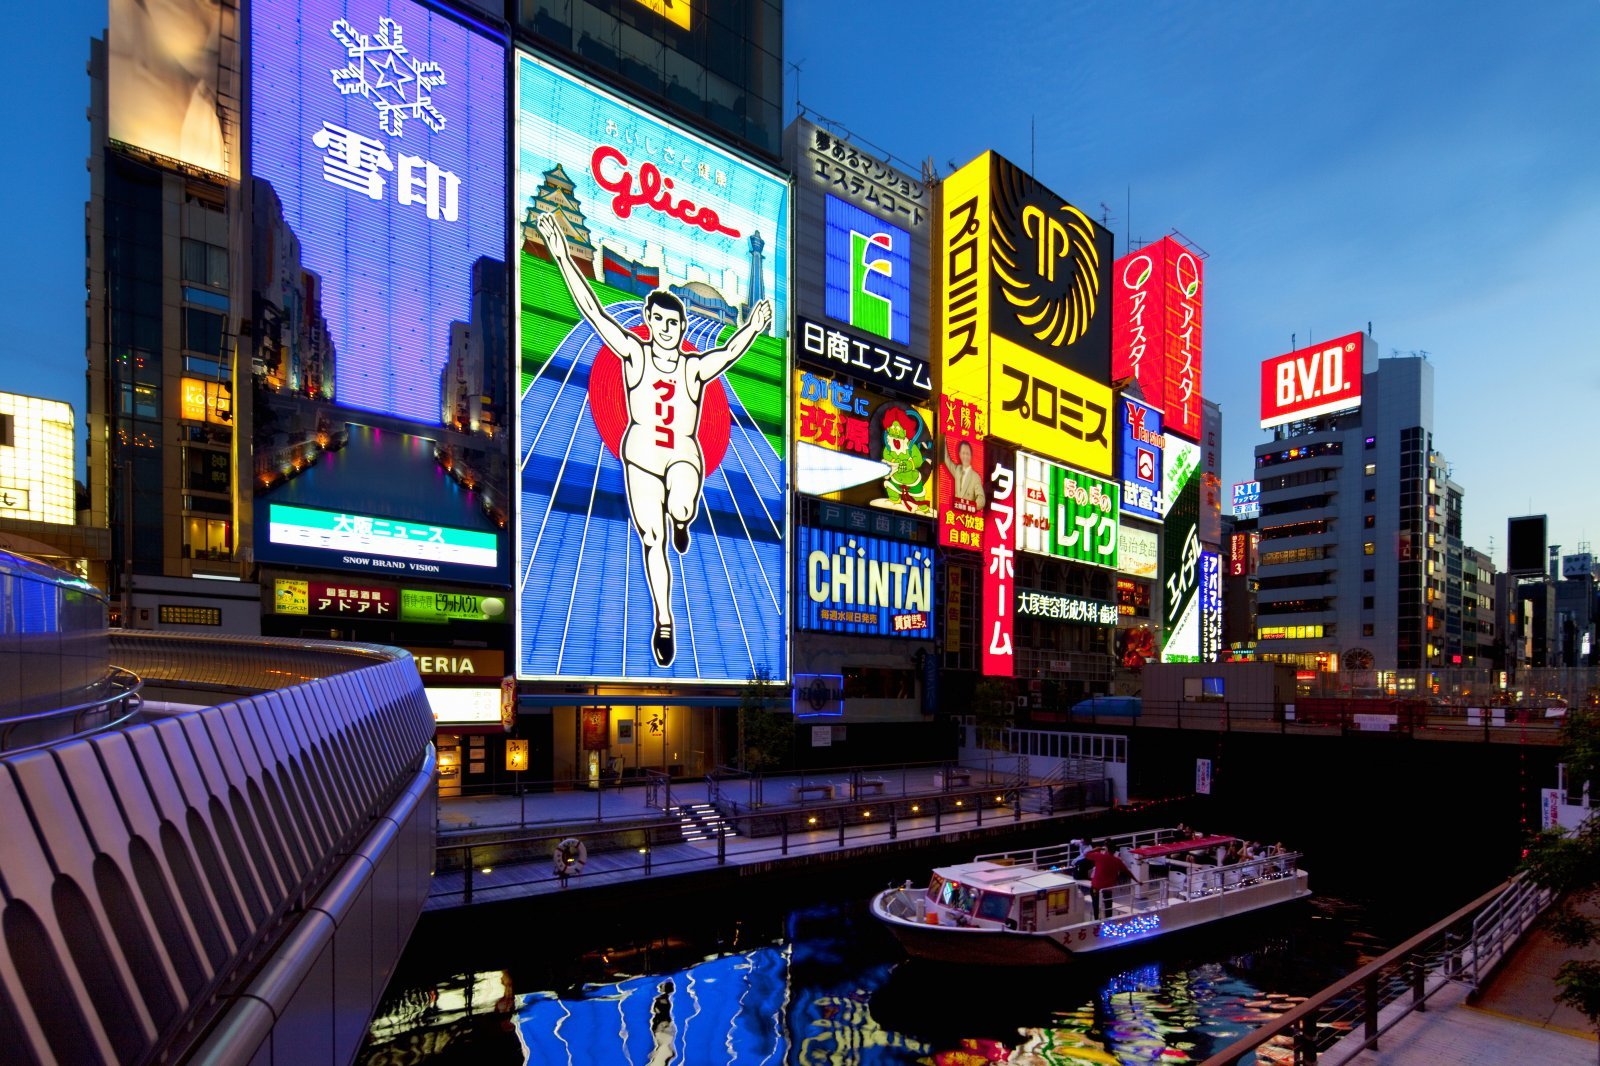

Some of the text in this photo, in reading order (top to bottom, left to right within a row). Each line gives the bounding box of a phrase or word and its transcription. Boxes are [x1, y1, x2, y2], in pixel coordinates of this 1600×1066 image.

[312, 121, 461, 222] 雪印
[605, 118, 727, 188] おいしさと健康
[815, 129, 924, 199] 夢あるマンション
[591, 145, 741, 238] Glico
[815, 158, 924, 225] エステムコート
[948, 195, 979, 367] プロミス
[804, 321, 933, 391] 日商エステム
[1128, 290, 1147, 381] アイスター
[1178, 302, 1195, 425] アイスター
[652, 379, 677, 449] グリコ
[800, 370, 870, 417] かぜに
[1002, 363, 1108, 449] プロミス
[799, 402, 870, 454] 改源
[1149, 431, 1166, 451] shop
[825, 505, 913, 535] 戸堂歯科
[1029, 490, 1042, 499] 4F
[1063, 477, 1112, 514] ほのぼの
[1123, 480, 1164, 514] 武富士
[333, 513, 446, 544] 大阪ニュース
[945, 510, 985, 532] 食べ放題
[1057, 503, 1117, 556] レイク
[343, 555, 440, 573] SNOW BRAND VISION
[990, 462, 1014, 656] タマホーム
[1166, 522, 1203, 622] エイブル
[1234, 563, 1242, 575] 3
[1237, 534, 1245, 561] カラオケ
[318, 598, 390, 614] アドアド
[435, 593, 479, 614] ピタットハウス
[821, 609, 878, 625] 毎週水曜日発売
